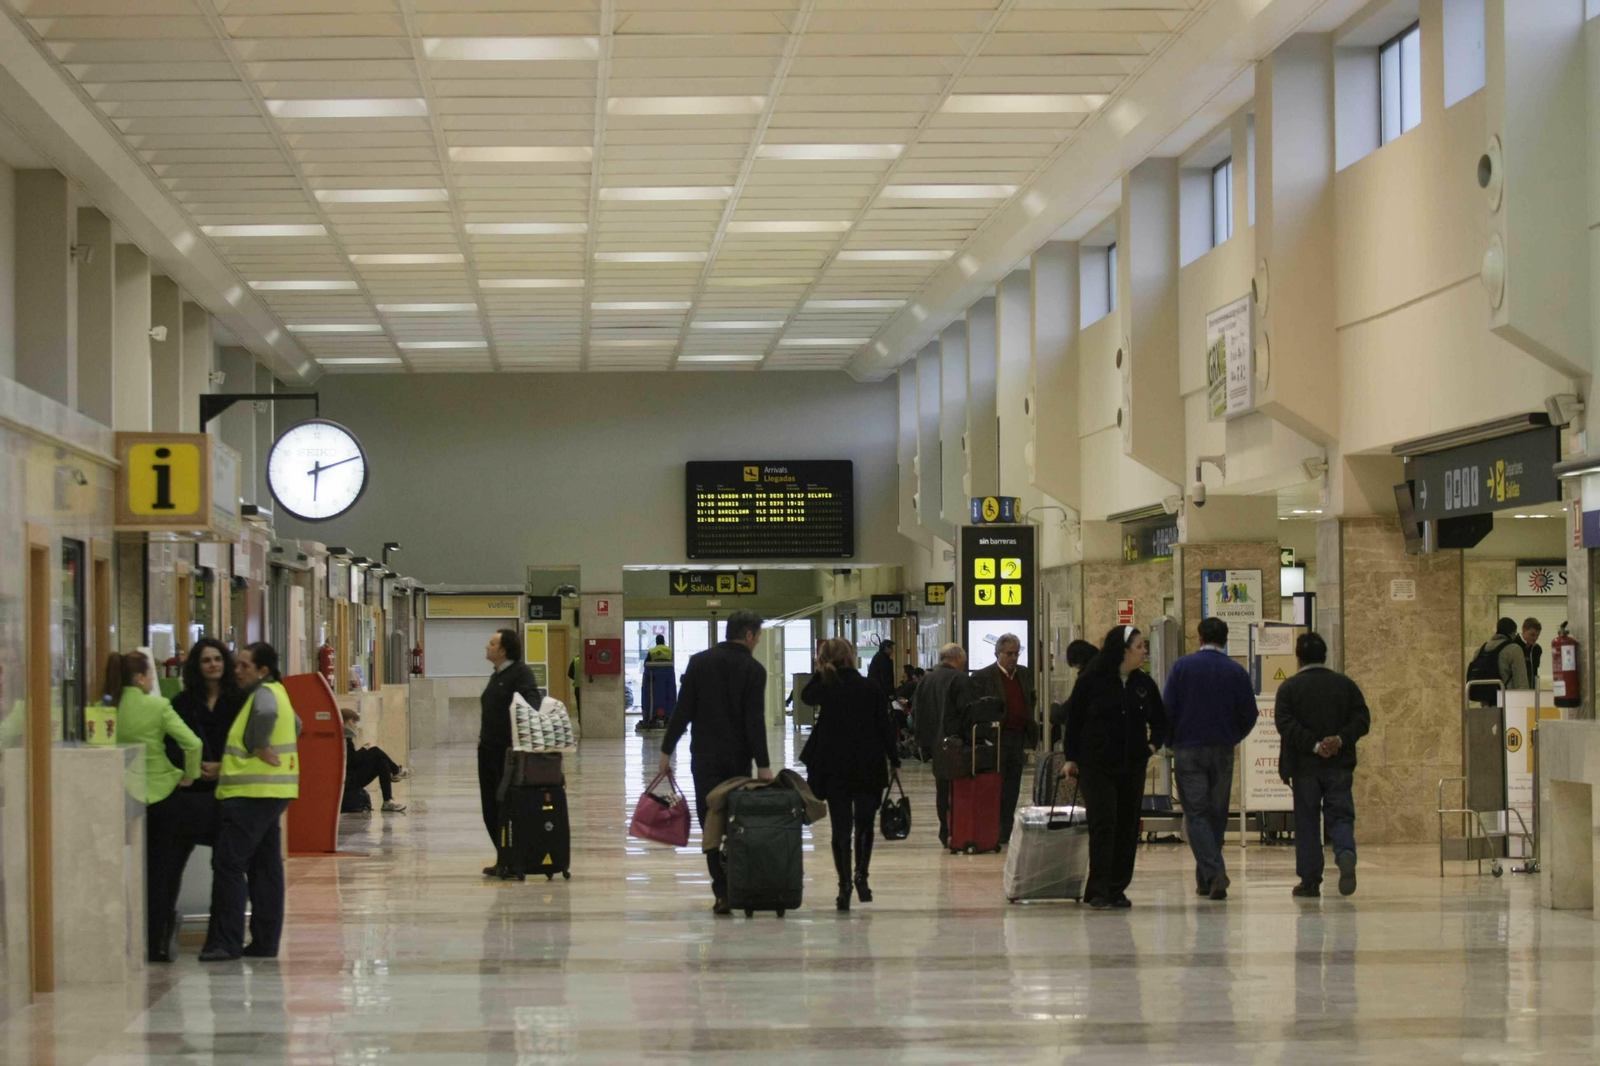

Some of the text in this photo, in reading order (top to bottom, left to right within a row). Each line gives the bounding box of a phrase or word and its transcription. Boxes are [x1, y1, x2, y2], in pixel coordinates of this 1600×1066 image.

[1505, 462, 1524, 477] Departures
[1506, 482, 1520, 498] Salidas
[487, 601, 515, 610] vueling
[1255, 758, 1279, 766] ATTE
